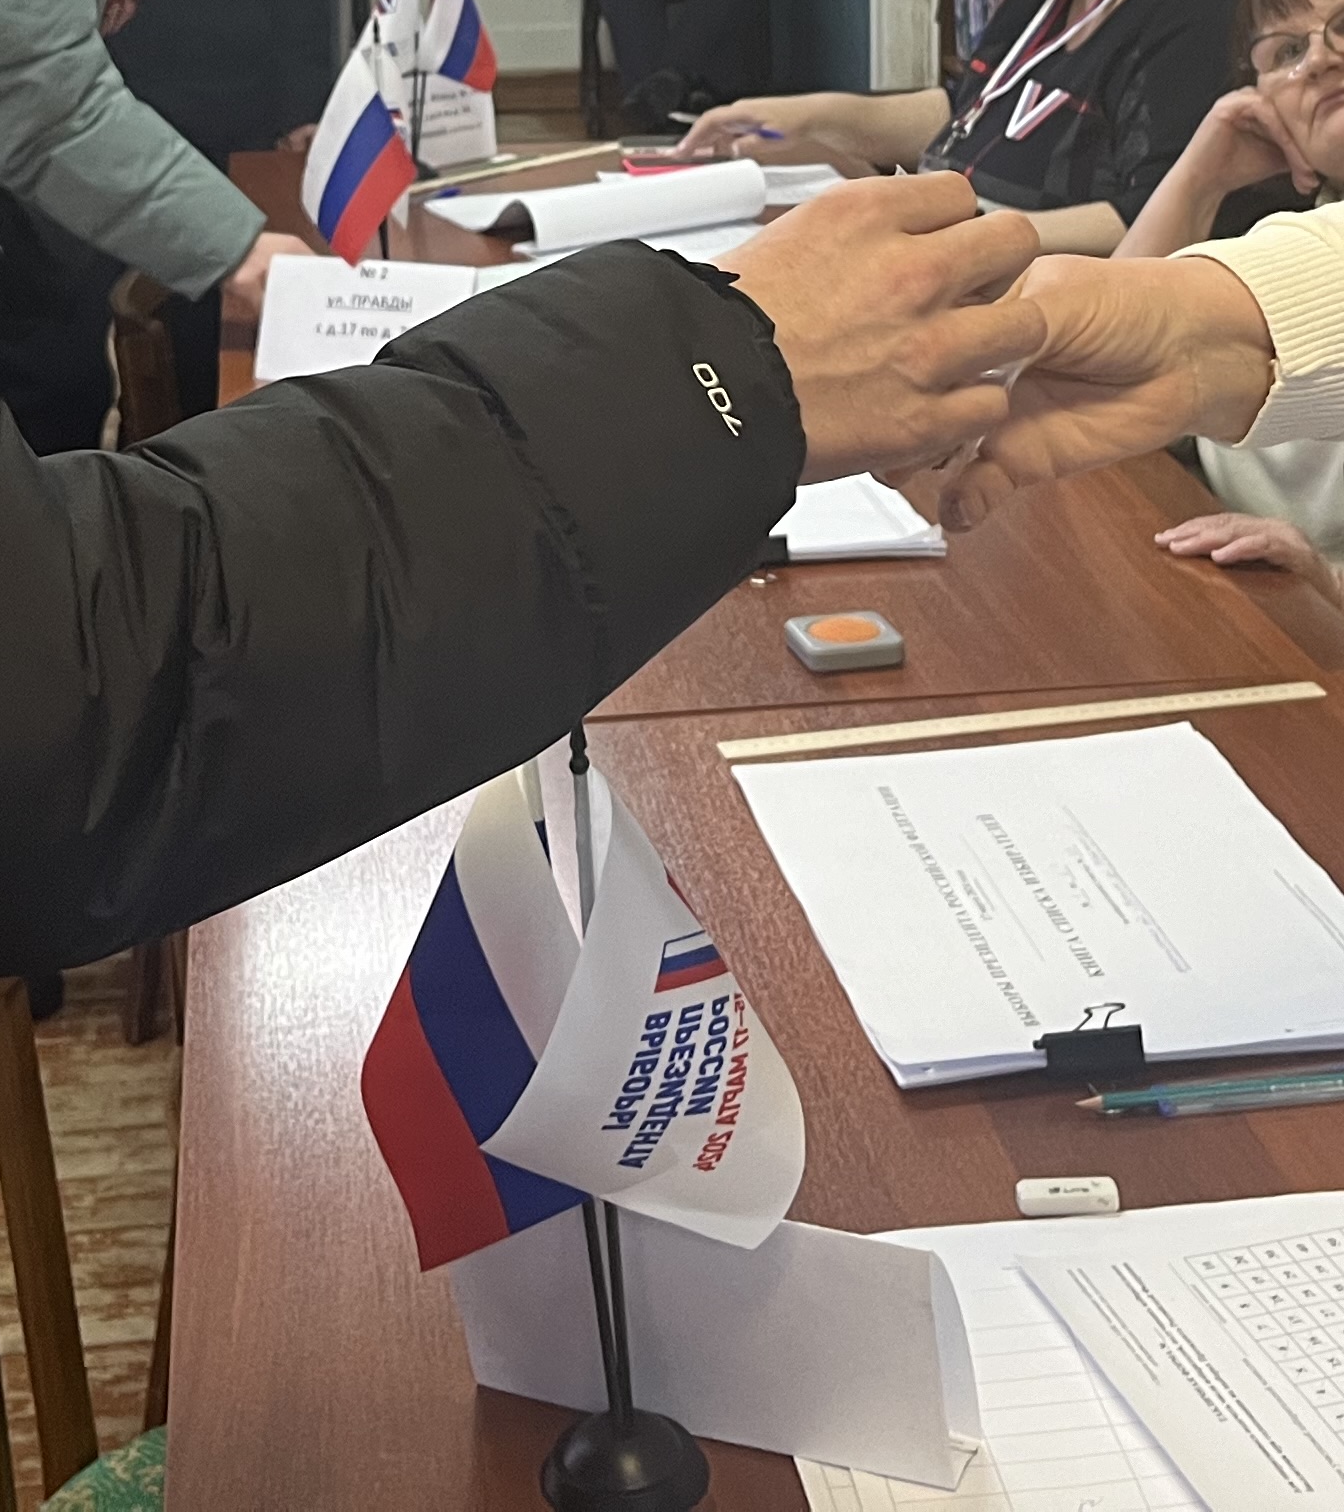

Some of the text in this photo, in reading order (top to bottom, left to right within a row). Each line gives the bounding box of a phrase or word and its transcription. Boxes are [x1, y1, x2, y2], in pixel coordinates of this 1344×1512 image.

[352, 294, 413, 312] ПРАВДЫ
[692, 362, 742, 437] 700
[1064, 935, 1106, 978] КНИГА
